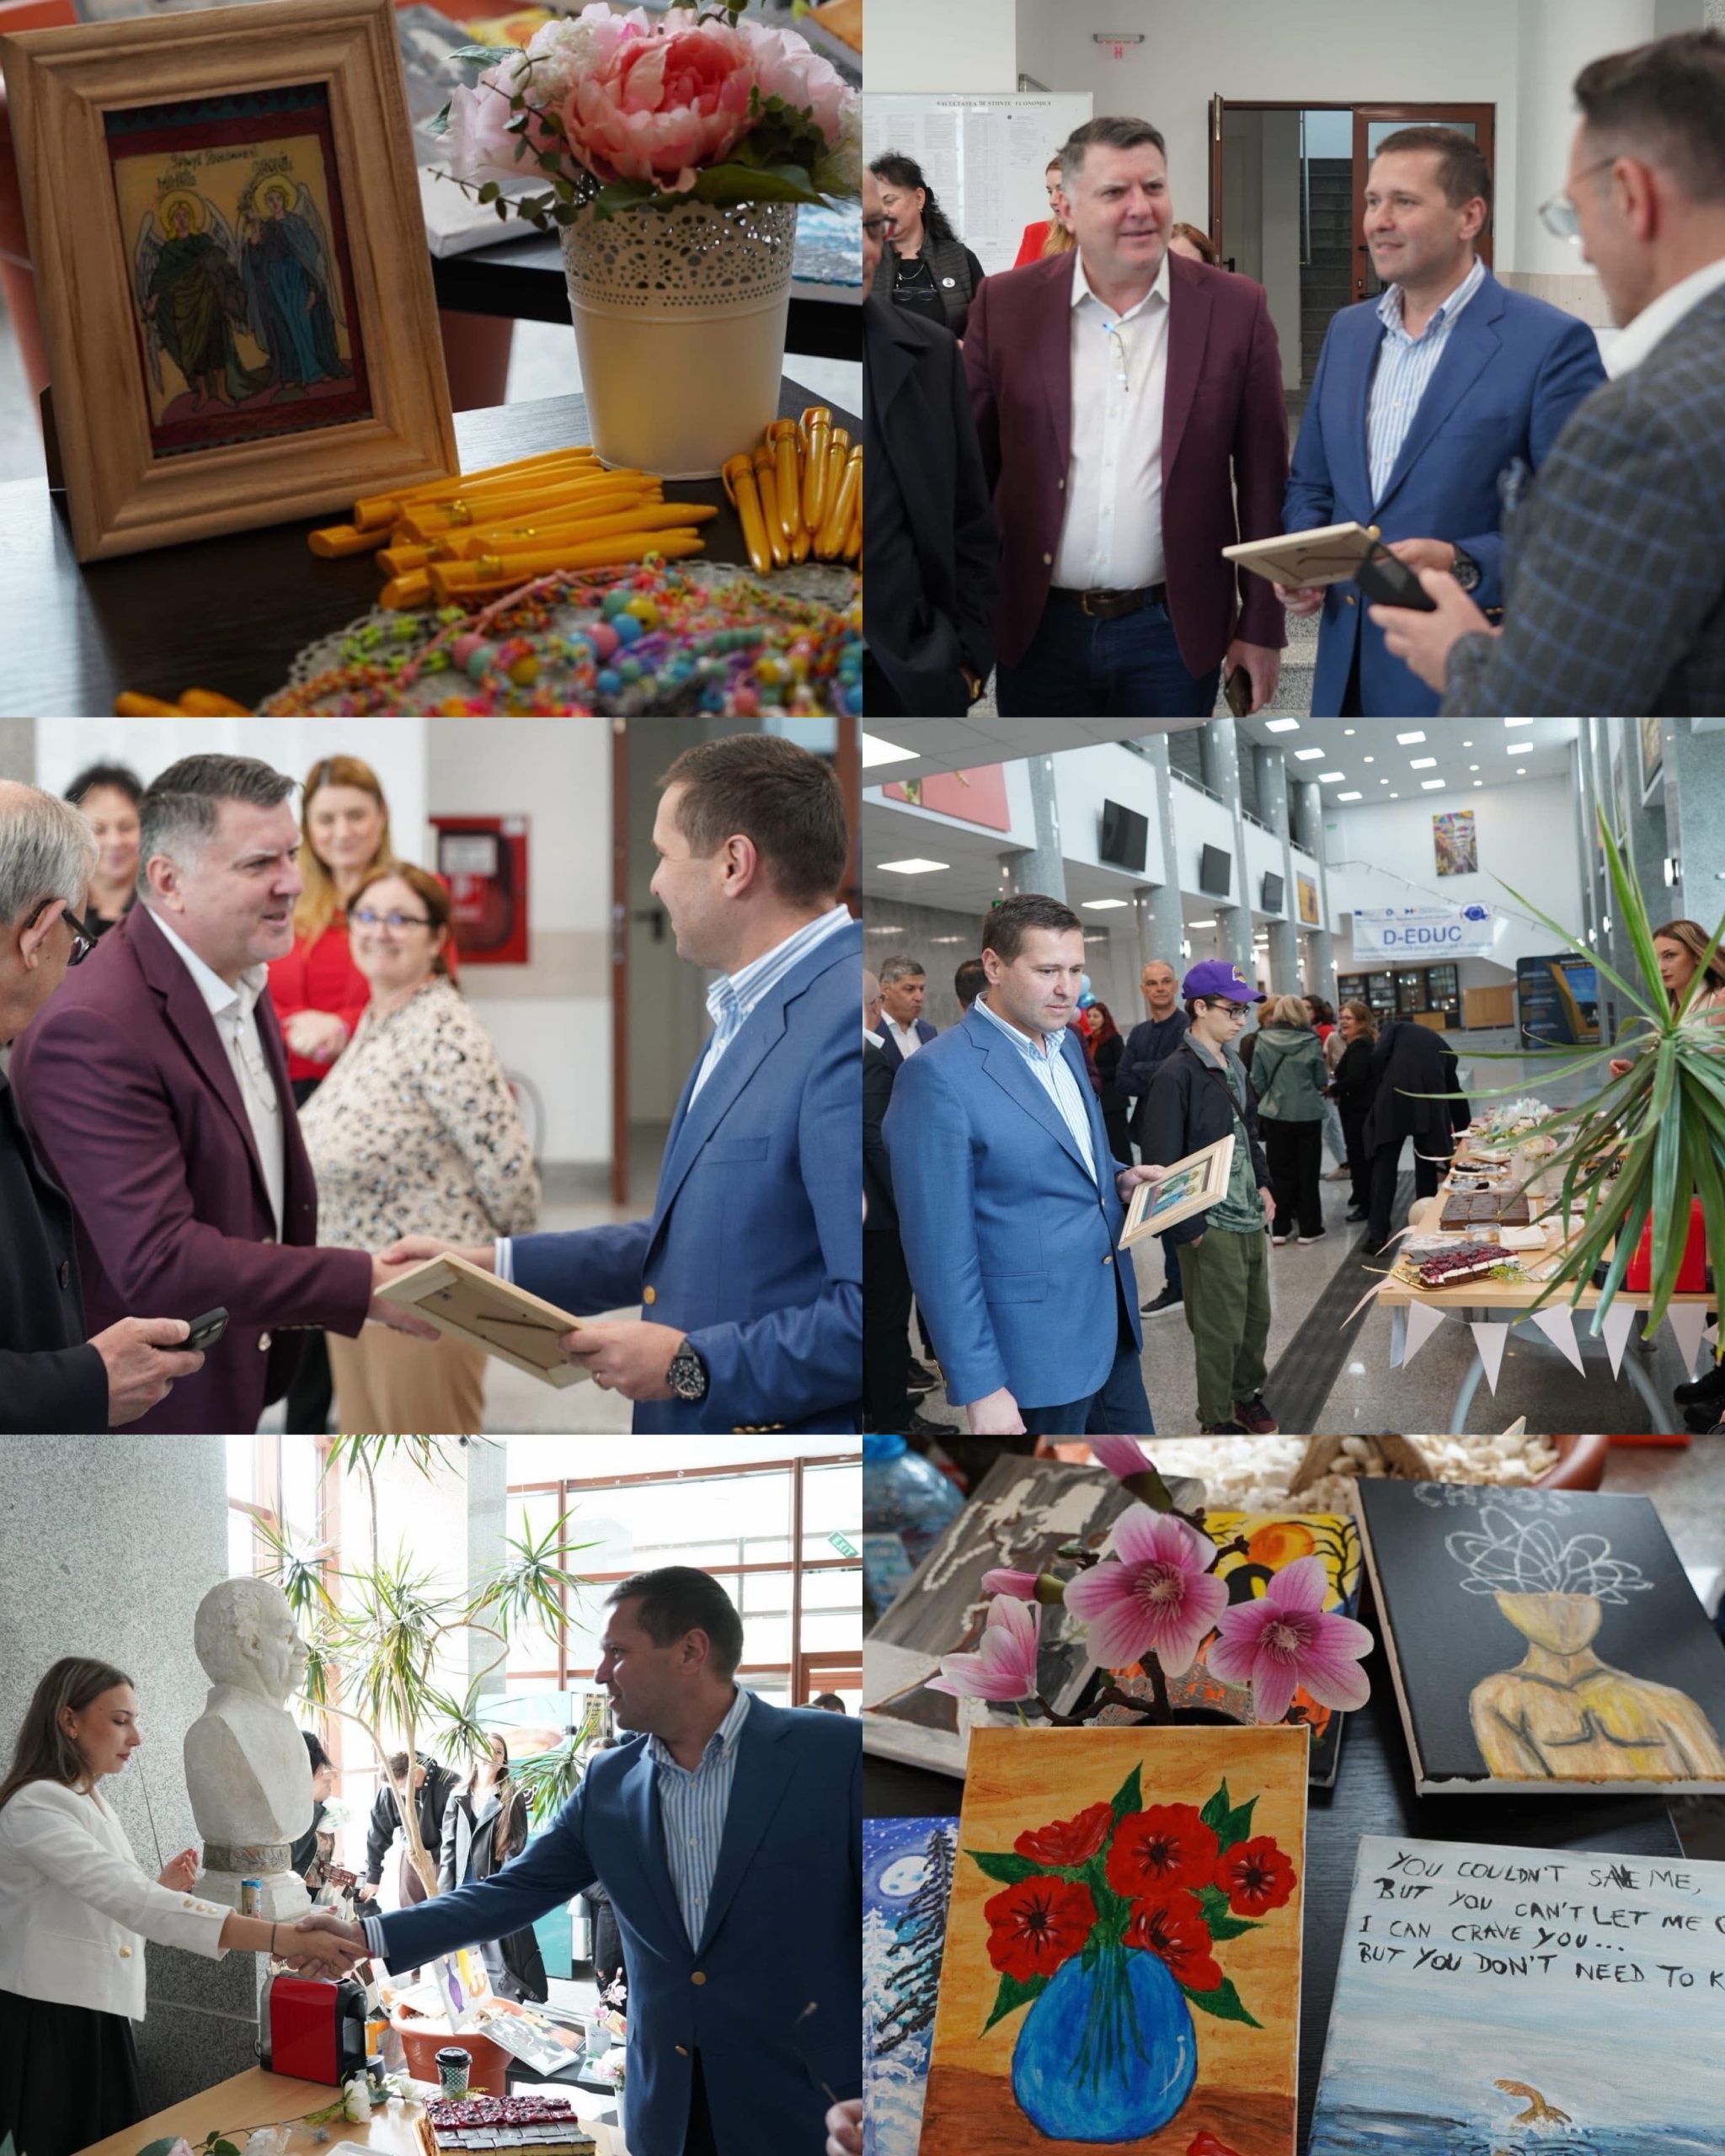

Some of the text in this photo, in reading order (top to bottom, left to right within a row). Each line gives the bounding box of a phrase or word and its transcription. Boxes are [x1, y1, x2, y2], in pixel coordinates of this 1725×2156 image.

[1383, 926, 1462, 945] D-EDUC
[1413, 1482, 1573, 1516] CHAOS
[1387, 1851, 1444, 1877] YOU
[1457, 1861, 1568, 1883] COULDN'T
[1649, 1869, 1701, 1895] ME,
[1373, 1877, 1434, 1899] BUT
[1448, 1890, 1493, 1910] YOU
[1515, 1902, 1584, 1923] CAN'T
[1593, 1906, 1652, 1929] LET
[1662, 1914, 1703, 1931] ME
[1358, 1915, 1625, 1951] I CAN CRAVE YOU...
[1358, 1942, 1406, 1964] BUT
[1413, 1946, 1462, 1972] YOU
[1473, 1952, 1558, 1977] DON'T
[1575, 1962, 1645, 1983] NEED
[1656, 1964, 1694, 1988] TO
